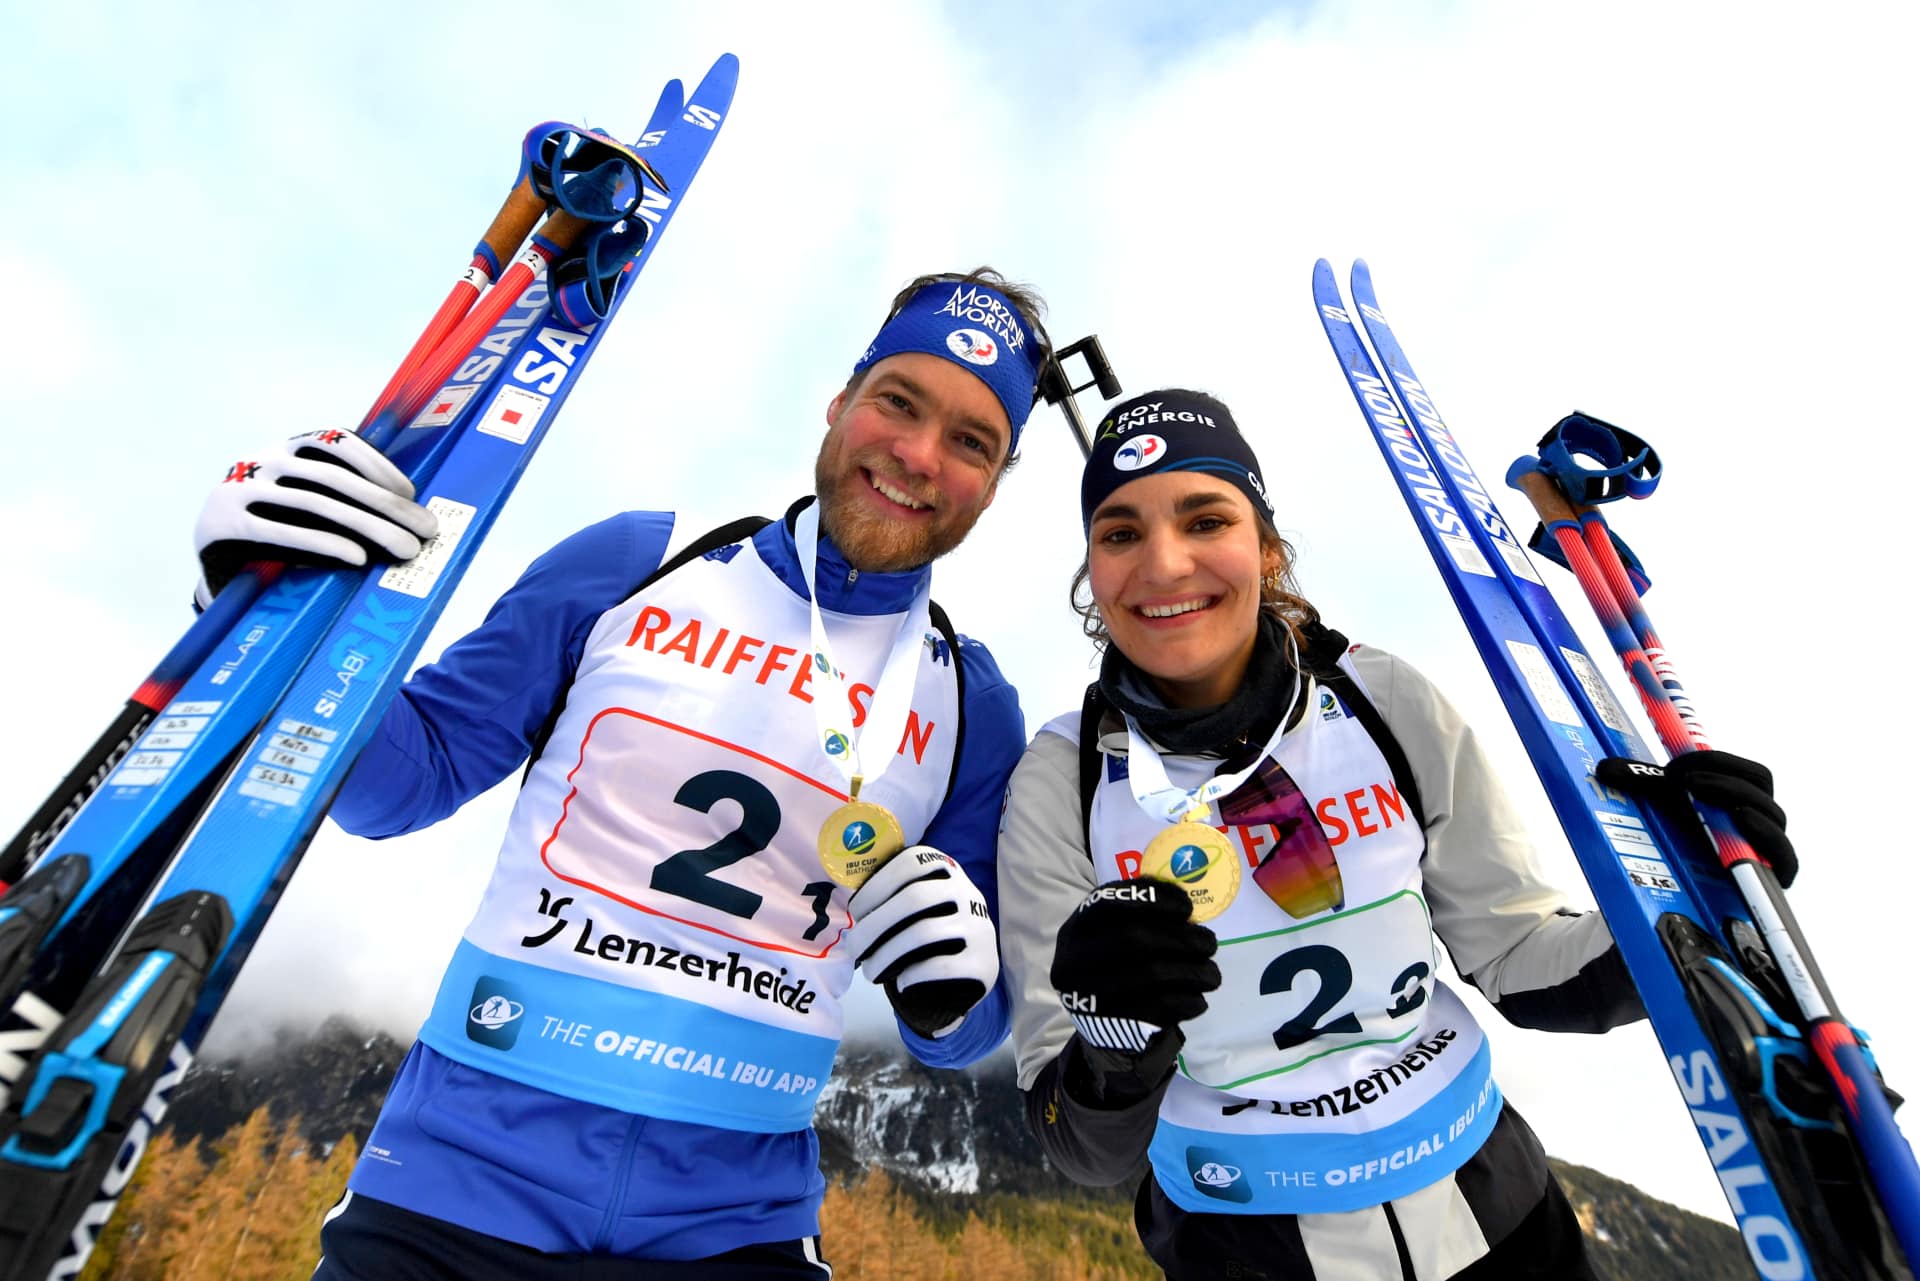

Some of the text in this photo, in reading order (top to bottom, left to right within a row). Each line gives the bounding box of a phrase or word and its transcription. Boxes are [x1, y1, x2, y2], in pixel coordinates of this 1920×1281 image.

[463, 269, 475, 281] 2
[452, 270, 549, 383] SALO
[933, 300, 1017, 355] AVORIAZ
[946, 285, 1025, 349] MORZINE
[1117, 412, 1216, 434] ENERGIE
[1118, 402, 1163, 424] ROY
[1351, 370, 1473, 541] SALOMON
[1394, 370, 1521, 550] SALOMON
[625, 605, 935, 766] RAIFFESN
[649, 769, 781, 920] 2
[846, 857, 878, 868] IBU CUP
[799, 881, 837, 941] 1
[1190, 888, 1209, 897] CUP
[574, 917, 817, 1015] Lenzerheide
[1259, 944, 1364, 1051] 2
[540, 1015, 818, 1098] THE OFFICIAL IBU APP
[1265, 1171, 1317, 1187] THE
[1324, 1133, 1444, 1186] OFFICIAL
[1449, 1103, 1475, 1143] IBU
[1670, 1050, 1806, 1281] SALO
